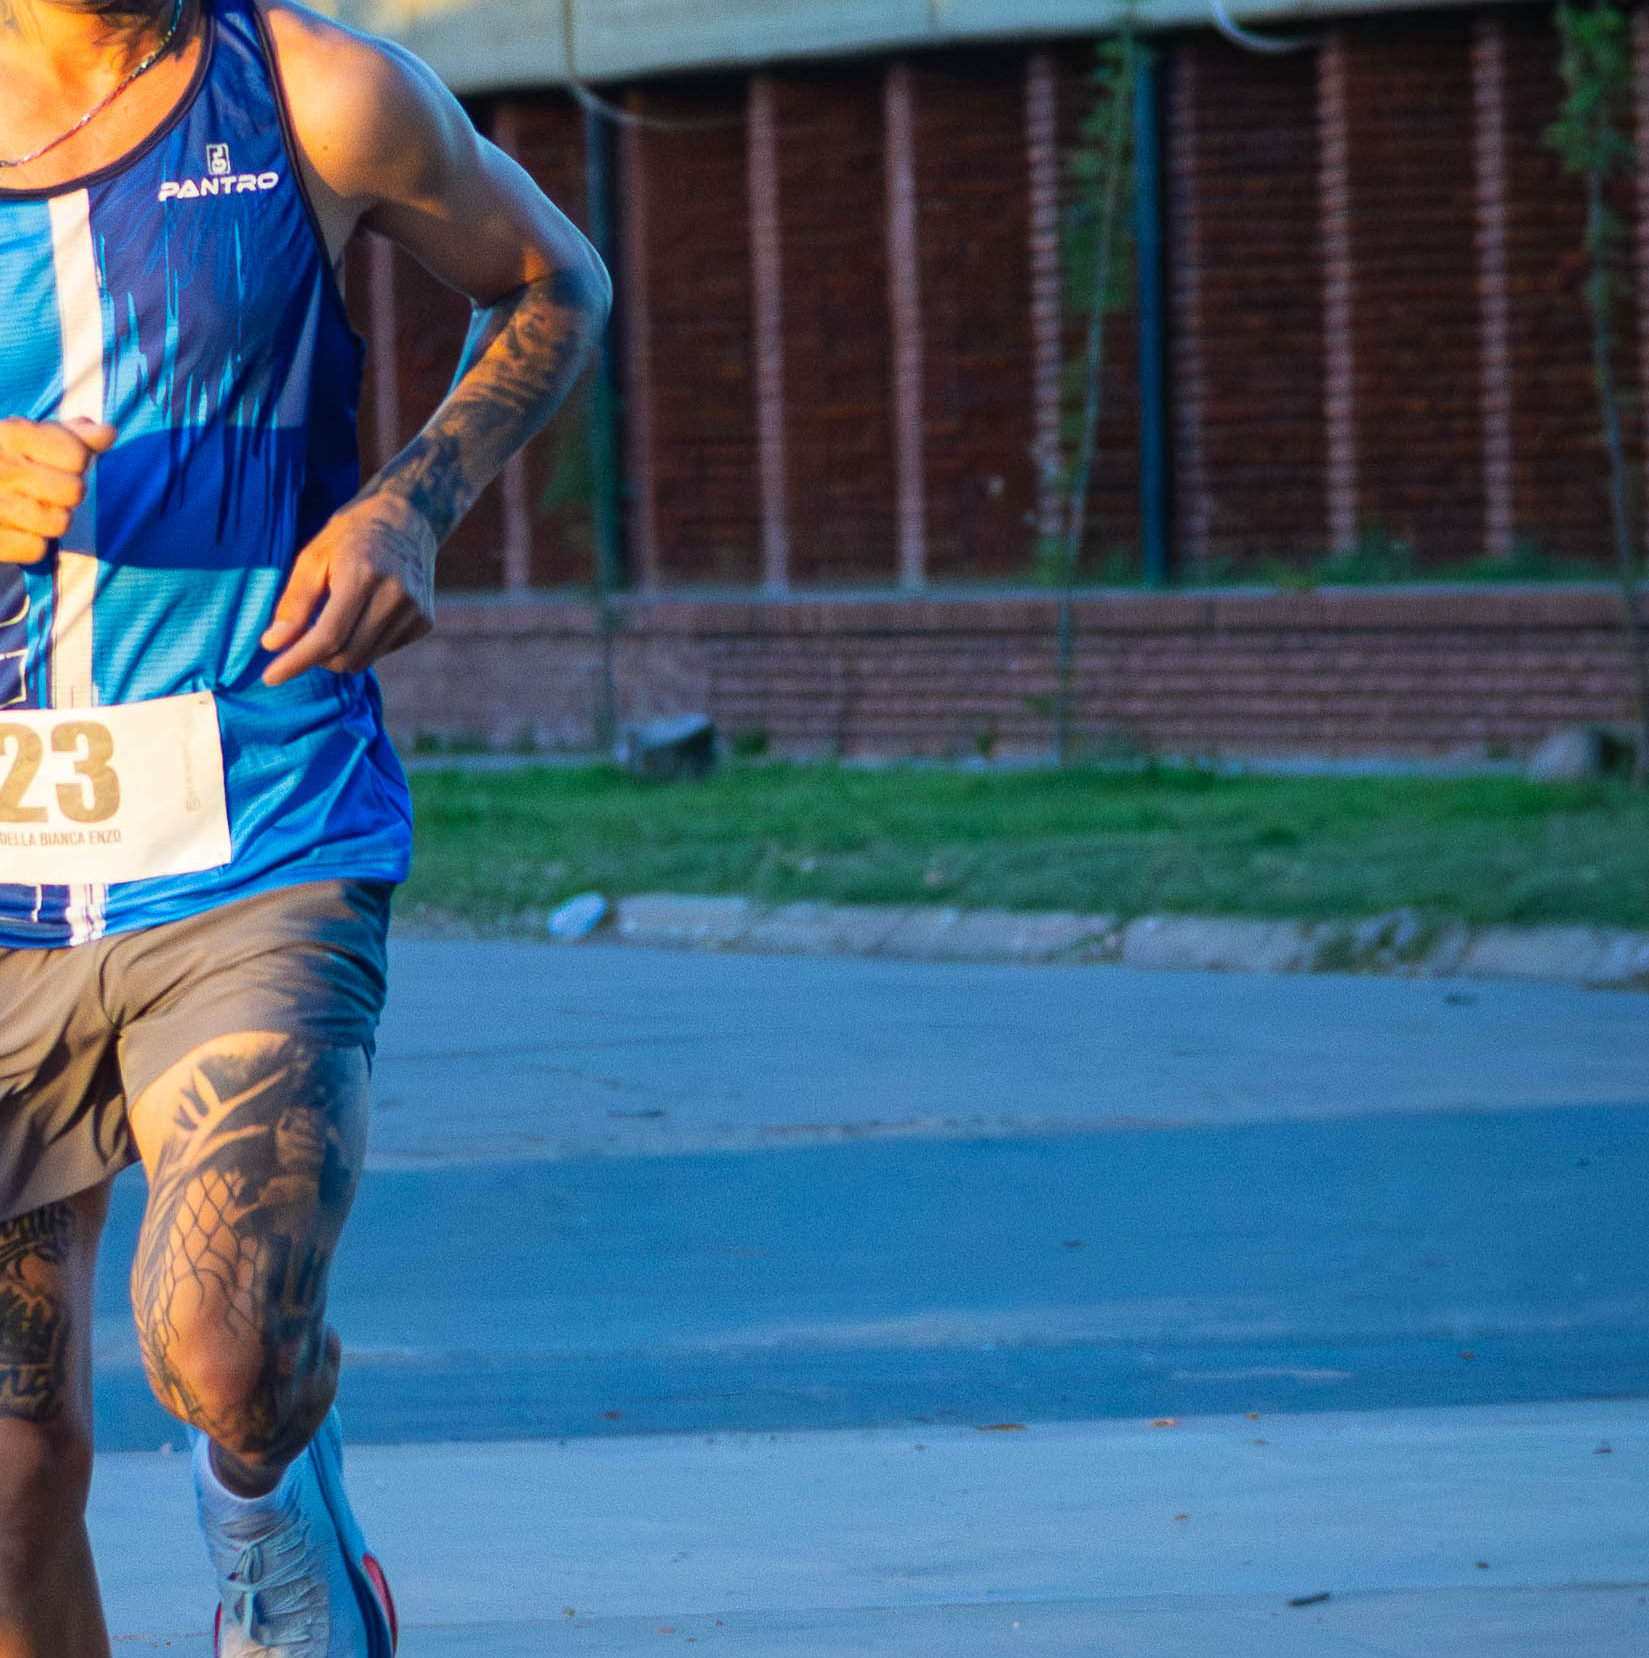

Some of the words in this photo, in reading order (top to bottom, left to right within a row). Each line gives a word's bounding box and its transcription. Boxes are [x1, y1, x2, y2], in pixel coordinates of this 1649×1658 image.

[159, 171, 279, 202] PANTRO
[0, 830, 36, 847] DELLA
[39, 830, 86, 847] BIANCA
[89, 829, 122, 845] ENZO
